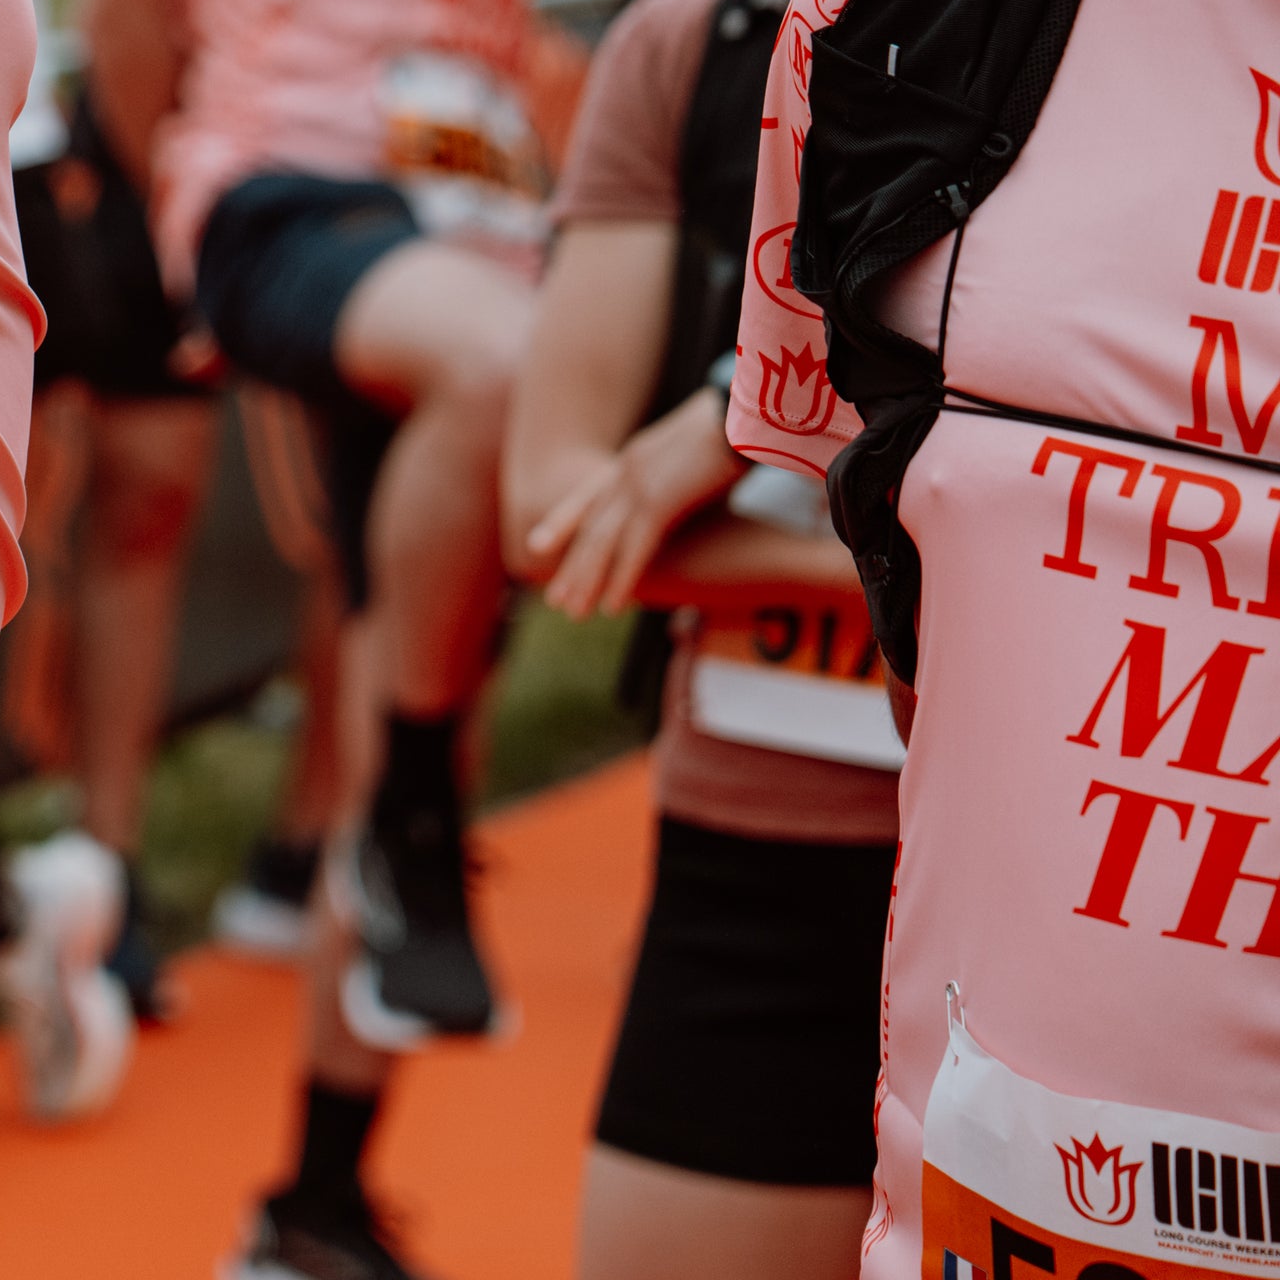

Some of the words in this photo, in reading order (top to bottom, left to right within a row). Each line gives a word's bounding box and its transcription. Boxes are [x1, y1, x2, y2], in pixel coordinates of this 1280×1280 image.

[1154, 1229, 1184, 1241] LONG
[1187, 1234, 1232, 1251] COURSE
[1235, 1243, 1280, 1257] WEEKEN
